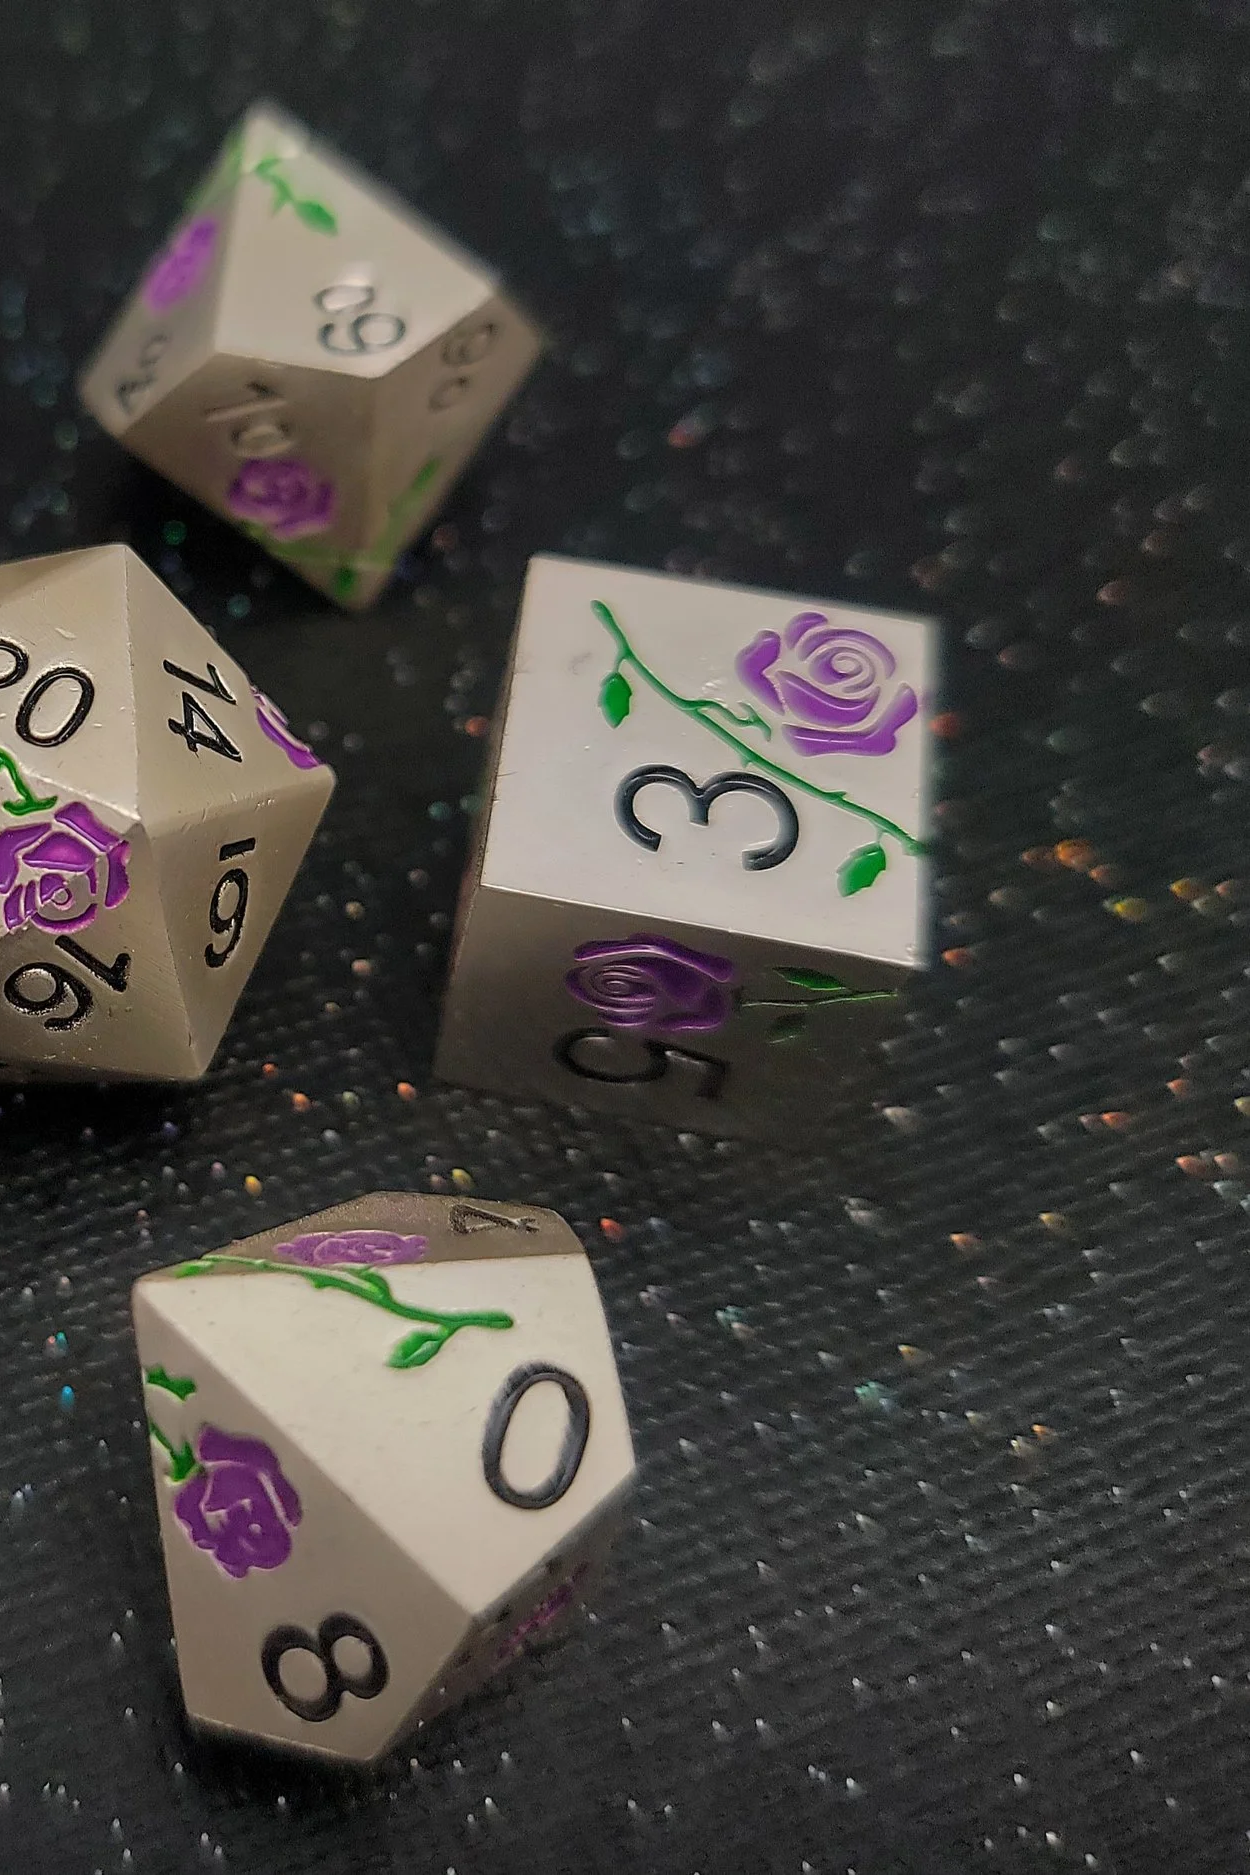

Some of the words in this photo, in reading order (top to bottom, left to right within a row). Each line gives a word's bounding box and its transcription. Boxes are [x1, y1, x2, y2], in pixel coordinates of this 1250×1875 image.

[162, 658, 244, 762] 14
[612, 762, 800, 872] 3
[553, 1026, 730, 1100] 5
[449, 1203, 541, 1235] 4
[481, 1360, 591, 1511] 0
[260, 1612, 391, 1723] 8
